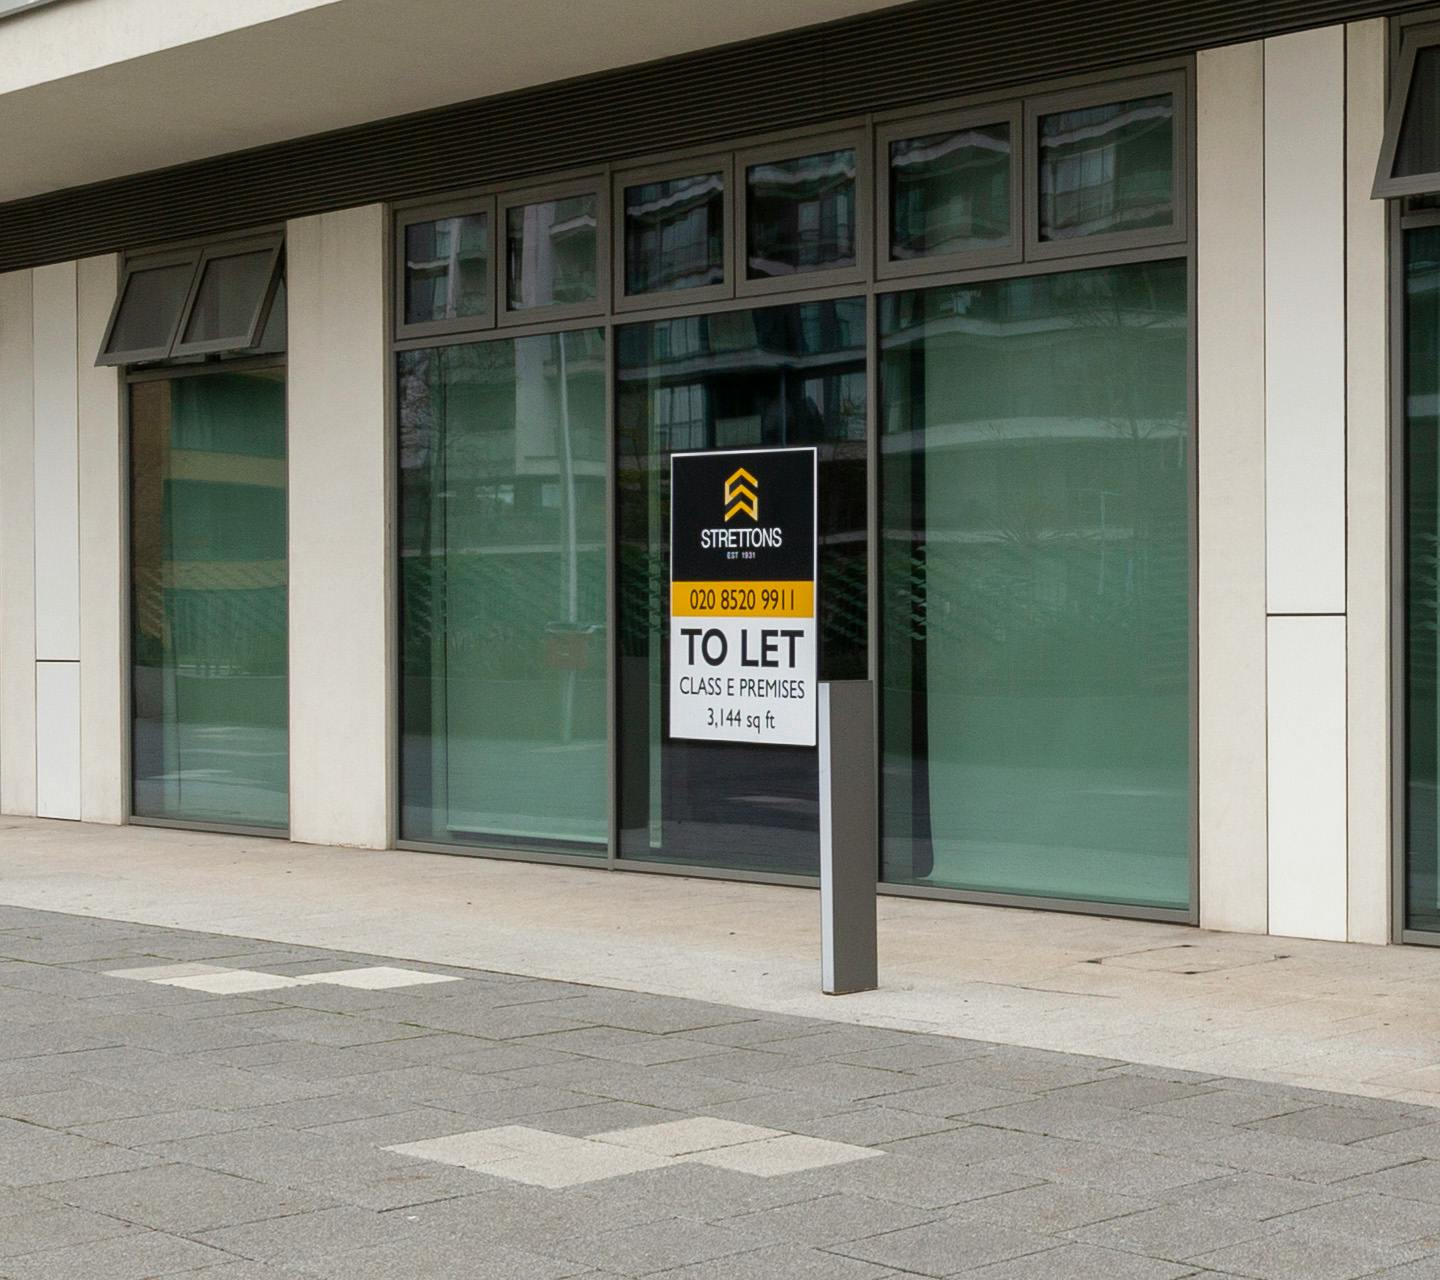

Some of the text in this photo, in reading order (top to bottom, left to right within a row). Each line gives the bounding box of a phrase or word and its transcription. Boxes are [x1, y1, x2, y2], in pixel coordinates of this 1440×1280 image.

[701, 527, 783, 549] STRETTONS
[726, 551, 756, 559] EST 1931
[690, 588, 796, 611] 020 8520 9911
[680, 628, 805, 668] TO LET
[679, 676, 805, 699] CLASS E PREMISES
[706, 707, 776, 734] 3,144 sq ft
